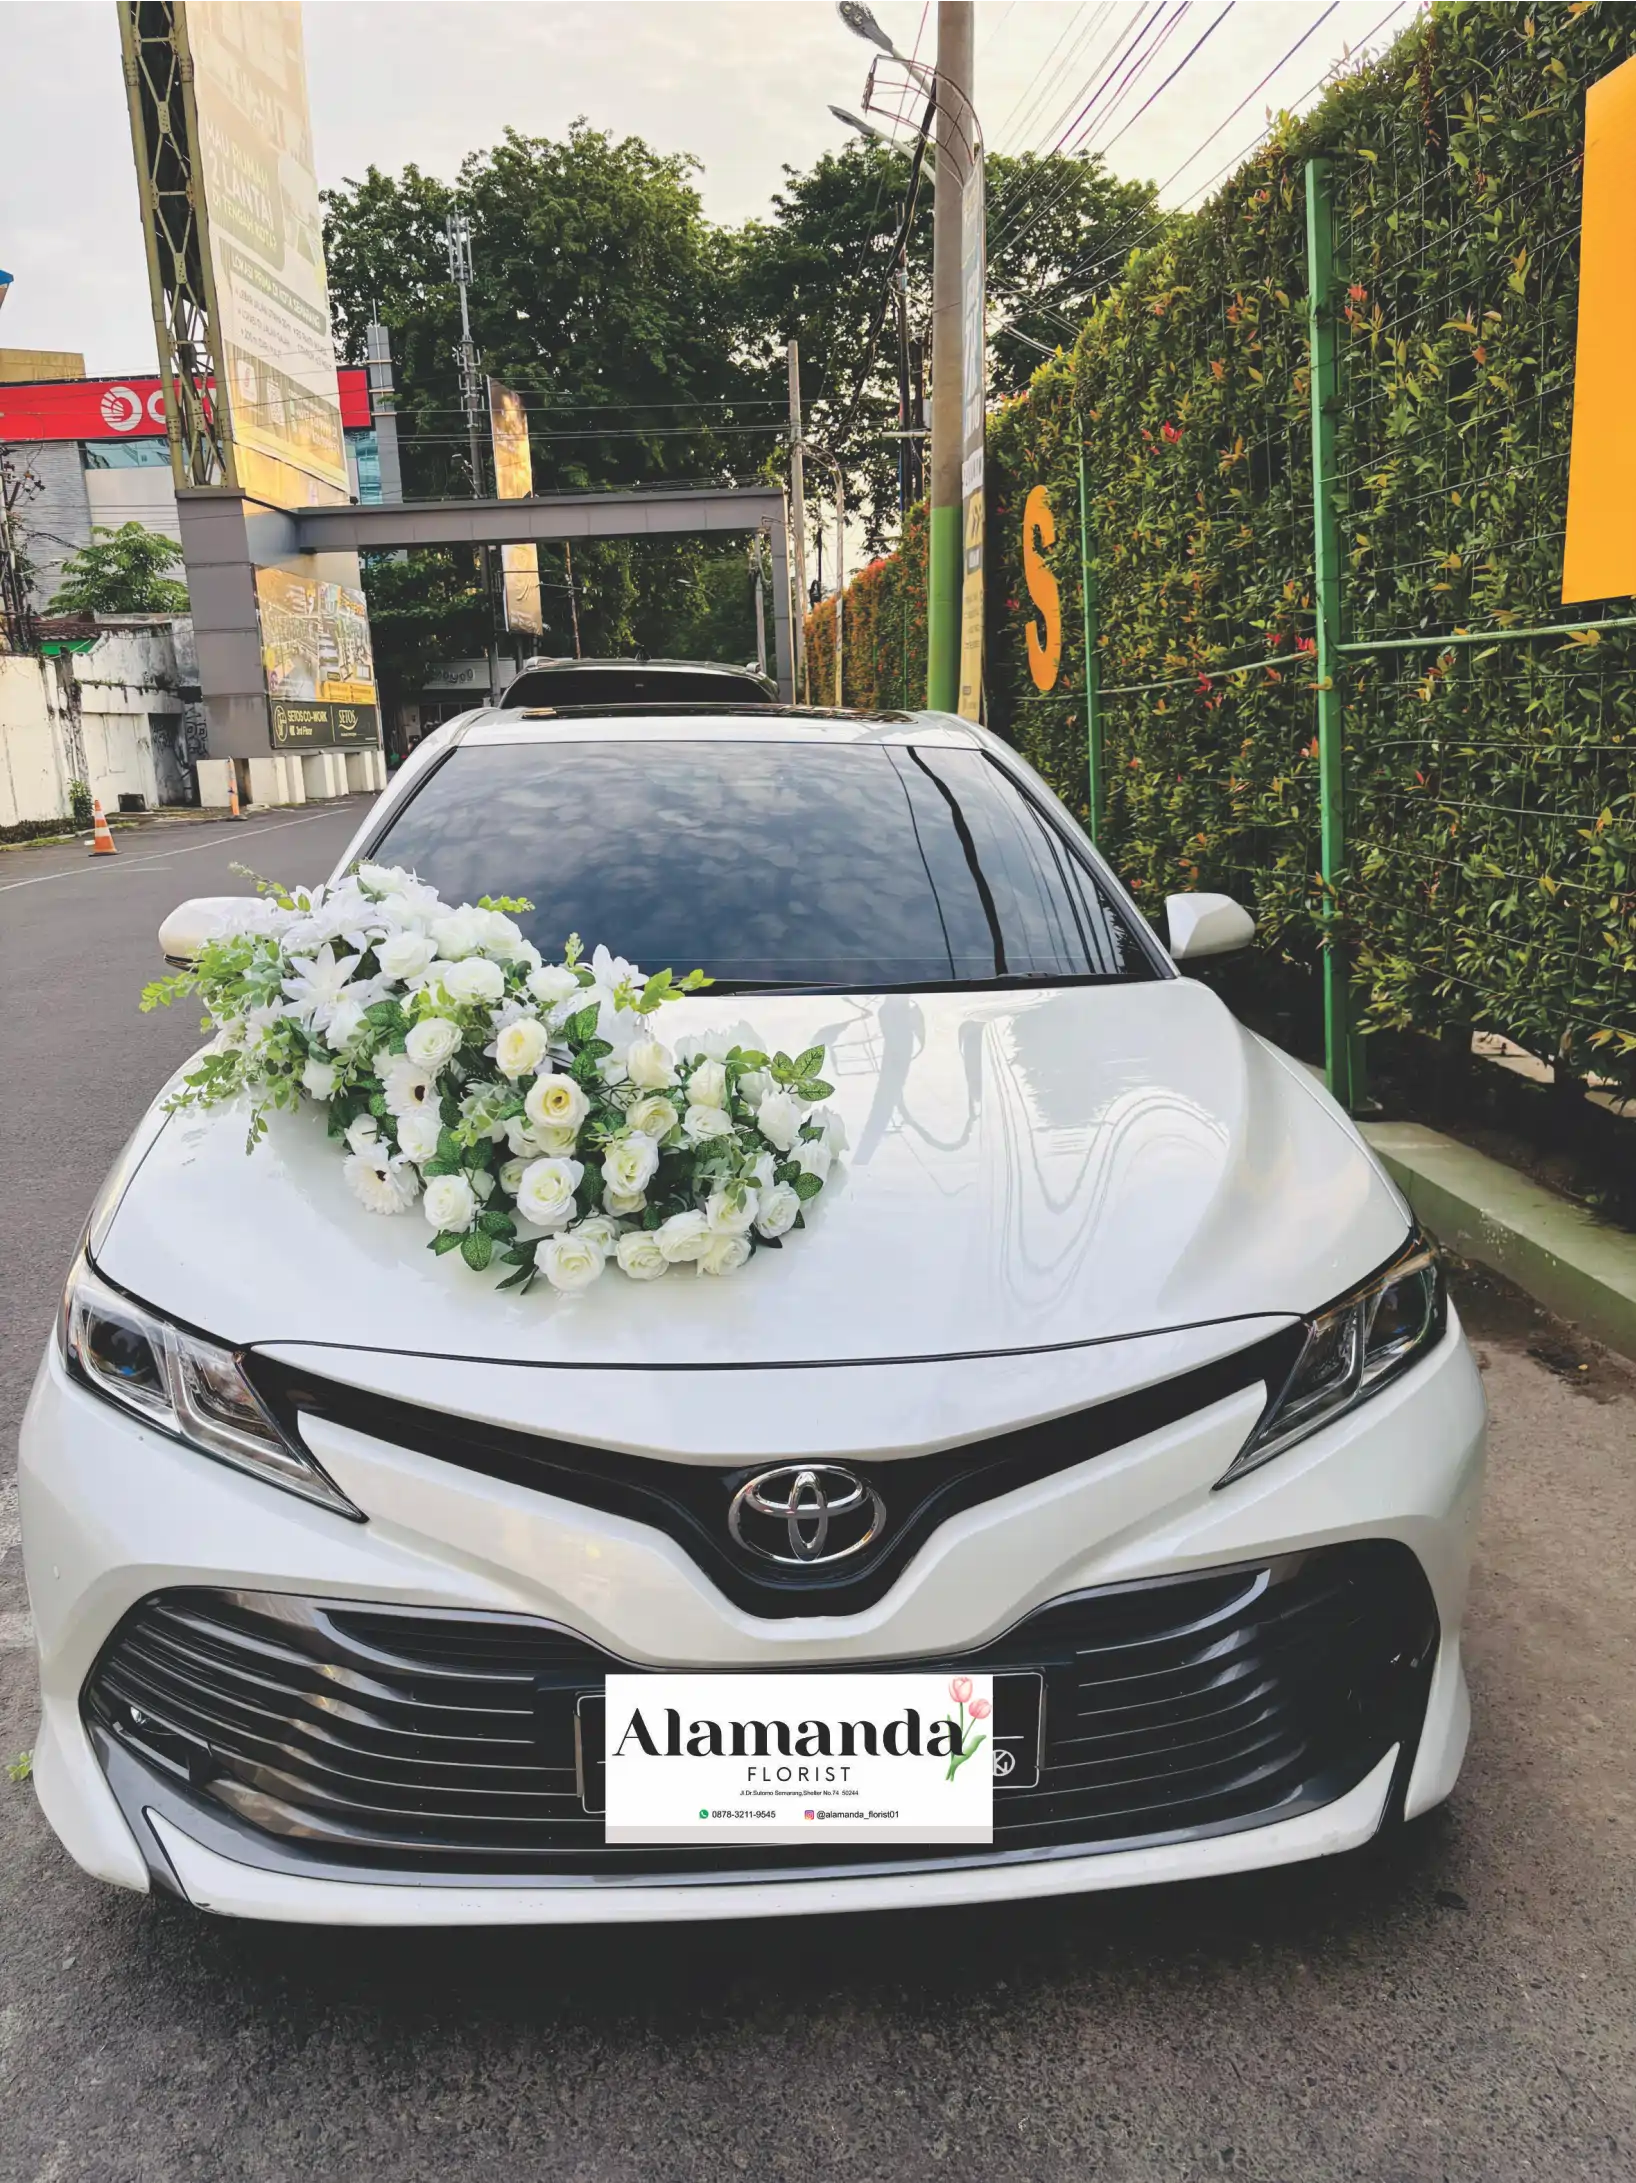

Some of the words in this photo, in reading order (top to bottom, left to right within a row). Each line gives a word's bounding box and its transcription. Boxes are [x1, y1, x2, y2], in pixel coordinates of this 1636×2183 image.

[222, 161, 274, 232] LANTAI
[1023, 485, 1062, 691] S
[338, 709, 356, 723] SETOS
